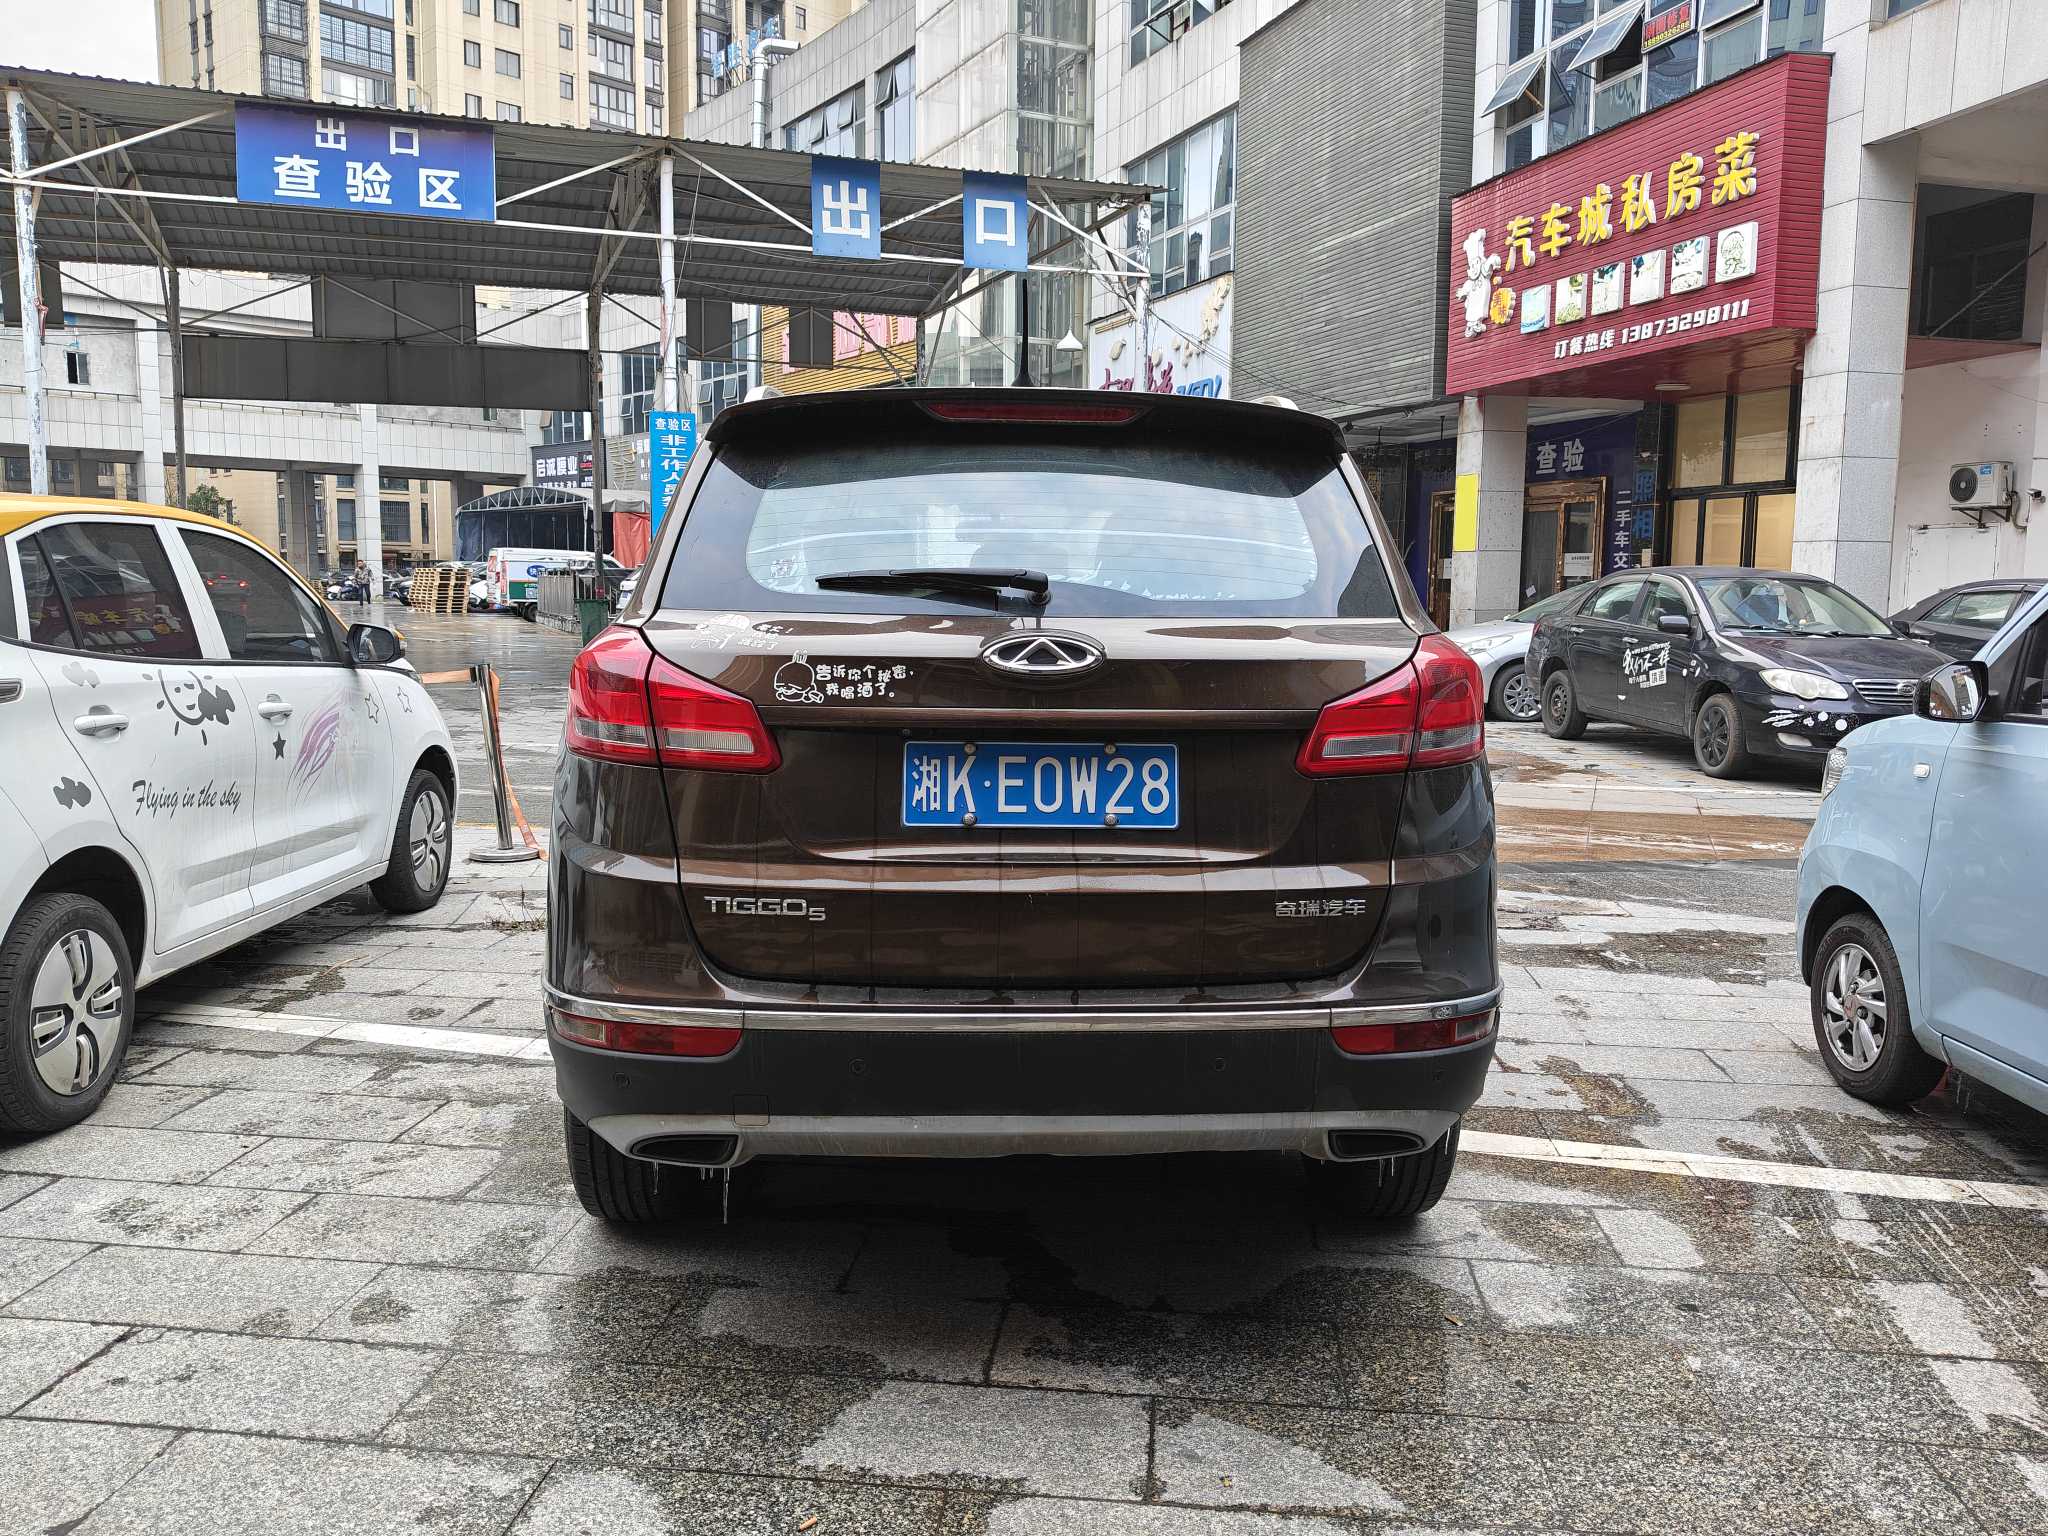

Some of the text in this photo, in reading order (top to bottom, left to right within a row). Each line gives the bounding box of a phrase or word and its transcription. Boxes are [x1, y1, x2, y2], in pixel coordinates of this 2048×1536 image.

[315, 117, 420, 157] 出口
[273, 153, 463, 211] 查验区
[1504, 131, 1760, 272] 汽车城私房菜
[821, 180, 870, 239] 出
[1554, 298, 1751, 359] 订餐热线 13873298111
[655, 416, 692, 432] 查验区
[1535, 438, 1585, 475] 查验
[1612, 489, 1632, 569] 二手车交
[132, 779, 241, 818] Flying in the sky
[1274, 898, 1367, 918] 奇瑞汽车
